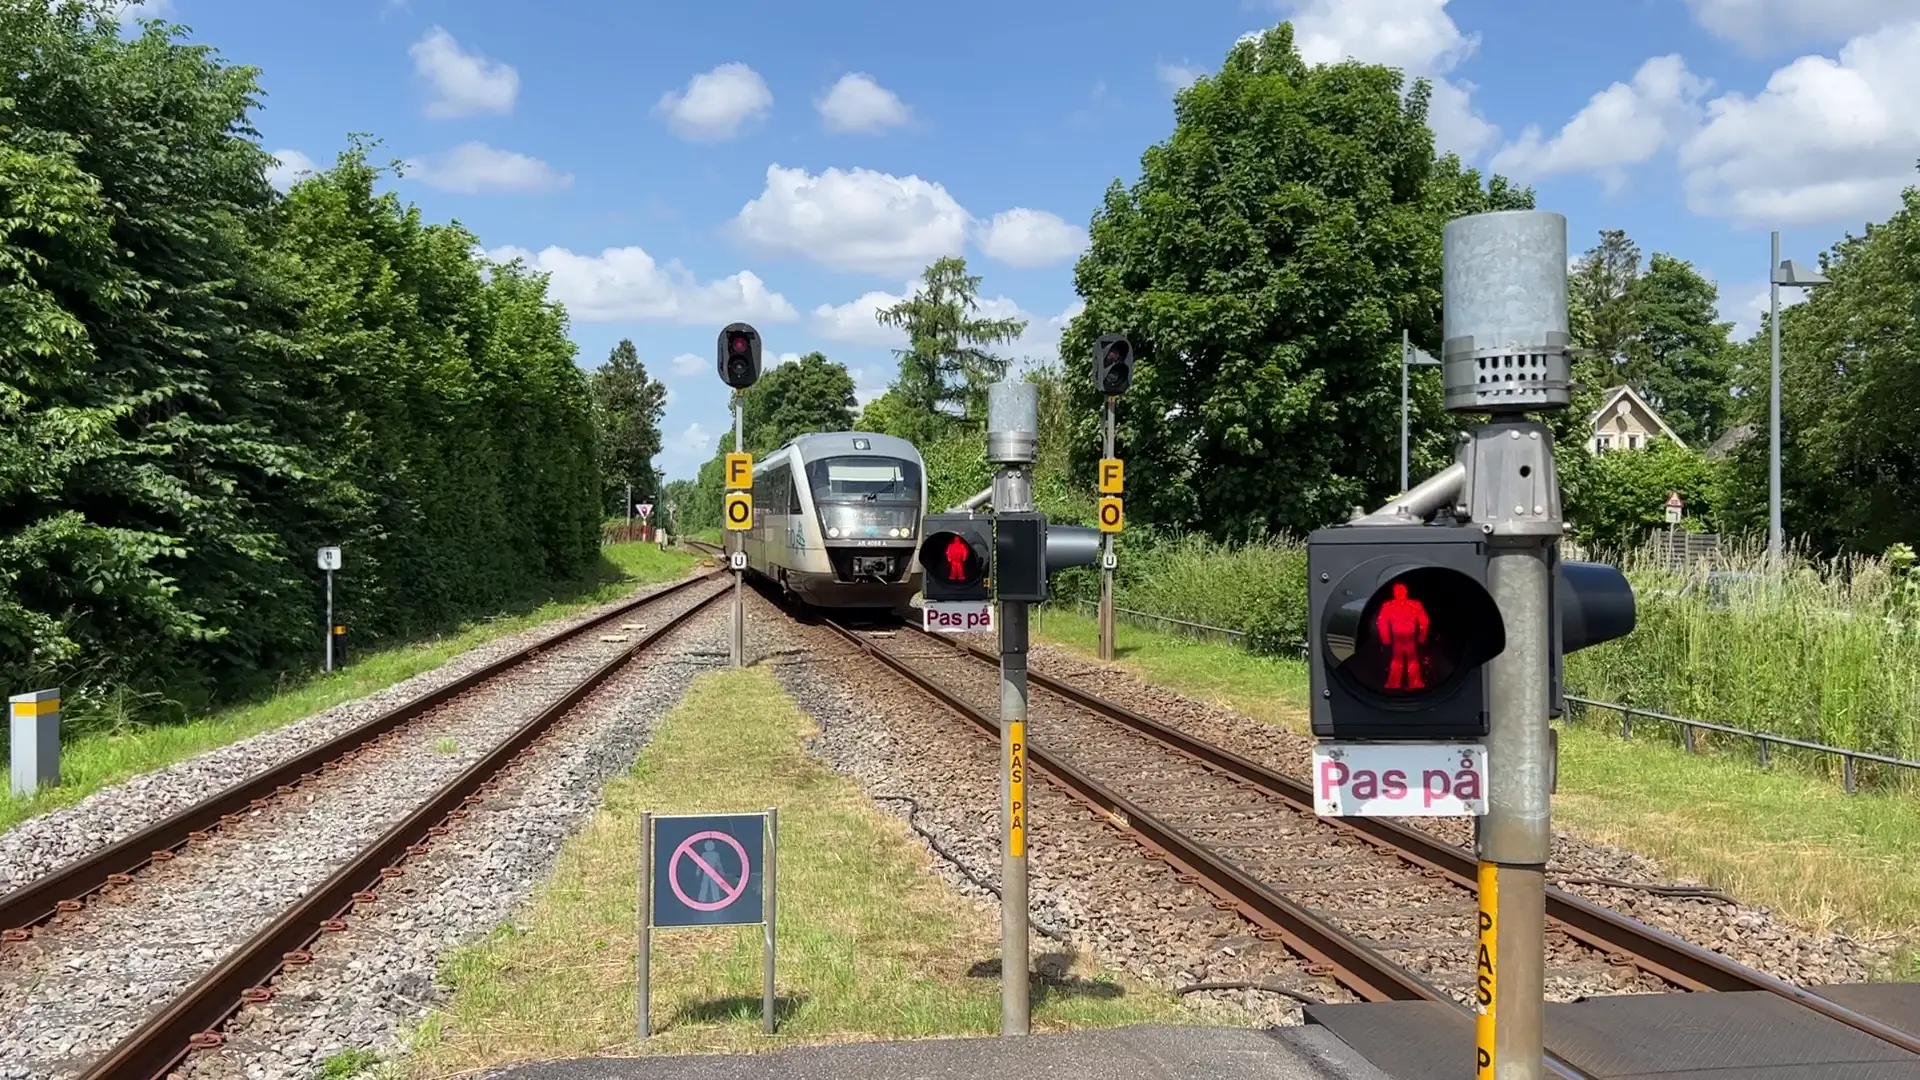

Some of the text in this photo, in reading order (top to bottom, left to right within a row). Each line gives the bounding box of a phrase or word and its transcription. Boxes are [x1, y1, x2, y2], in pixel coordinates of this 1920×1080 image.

[731, 460, 747, 482] F
[1104, 465, 1119, 486] F
[735, 555, 744, 566] U
[1105, 556, 1115, 566] U
[927, 607, 991, 628] Pas på
[1011, 743, 1022, 829] PAS PÅ
[1321, 757, 1481, 808] Pas på
[1477, 911, 1493, 1006] PAS
